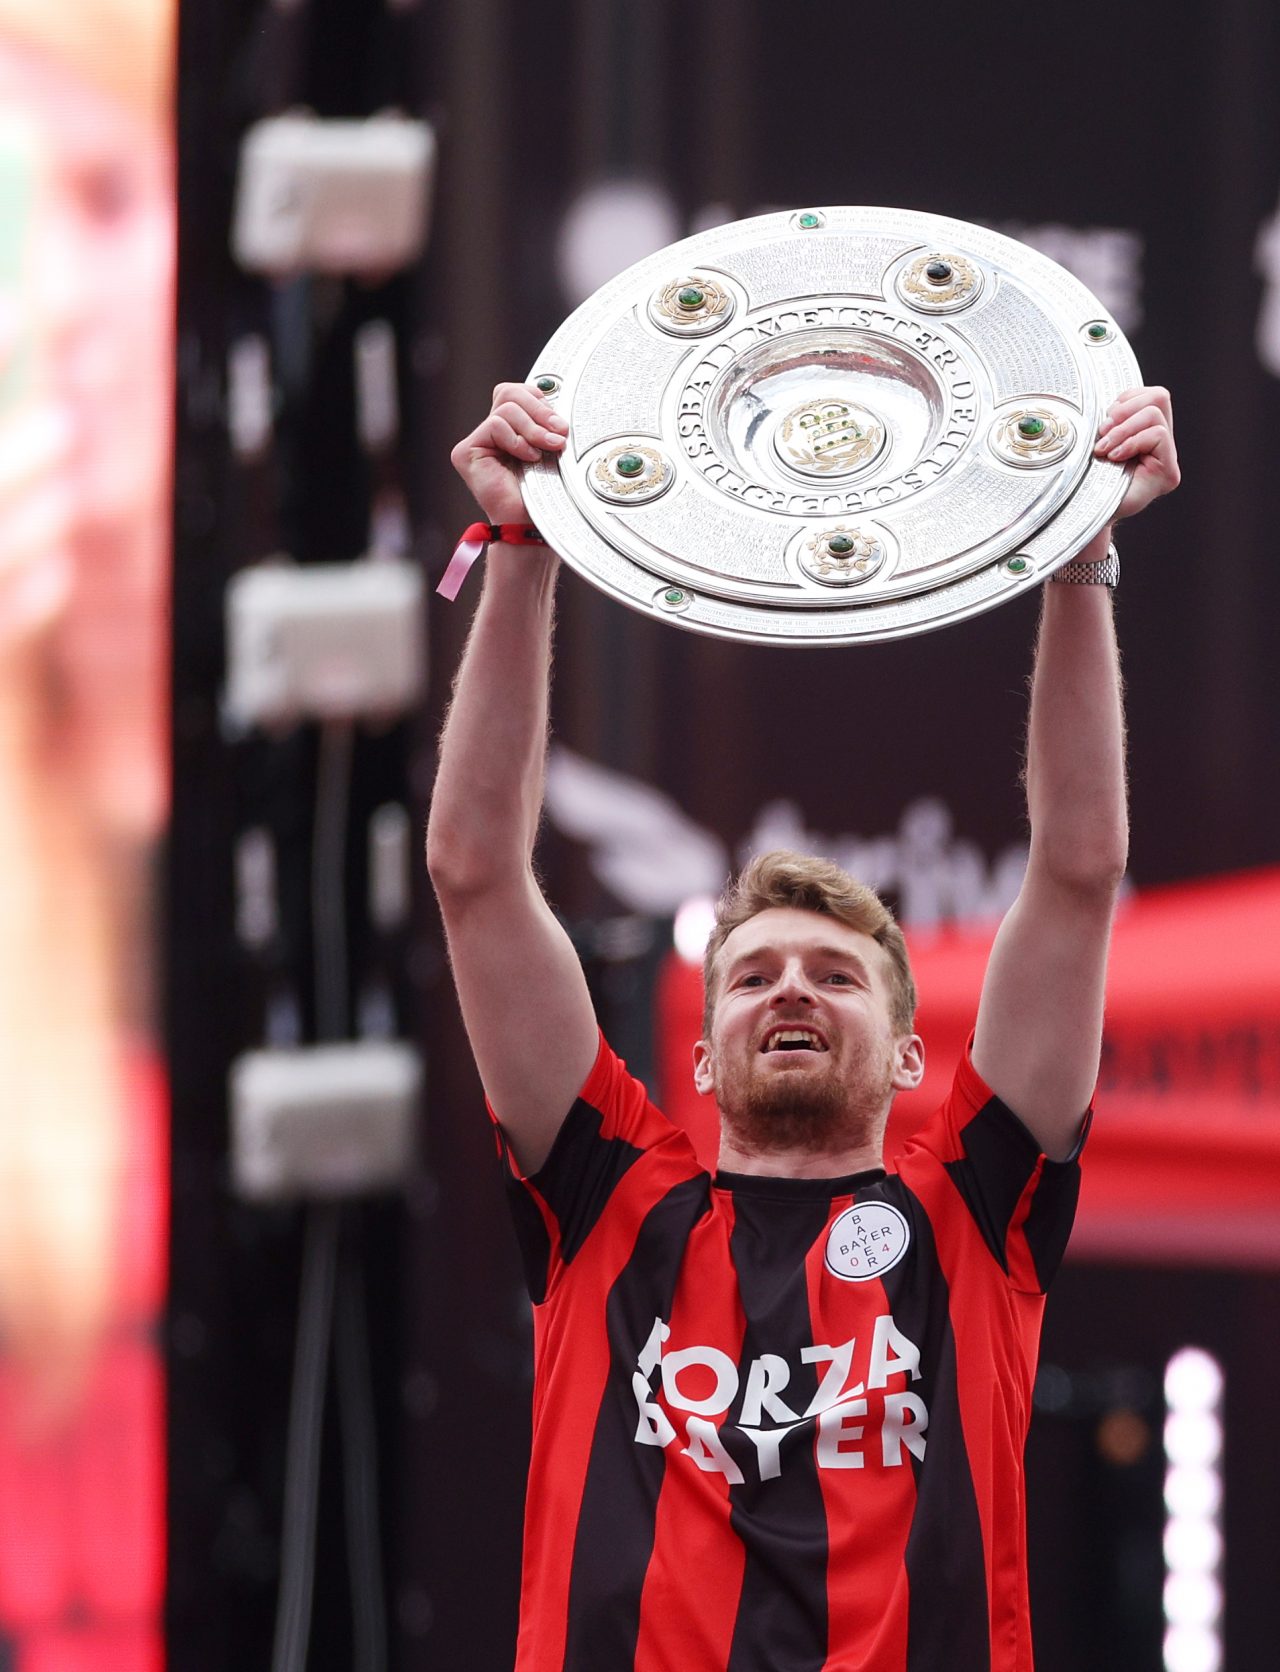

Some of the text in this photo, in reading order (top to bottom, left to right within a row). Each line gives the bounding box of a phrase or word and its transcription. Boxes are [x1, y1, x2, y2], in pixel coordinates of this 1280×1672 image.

[839, 1226, 893, 1256] BAYER
[637, 1314, 922, 1426] FORZA
[632, 1371, 929, 1485] BAYER
